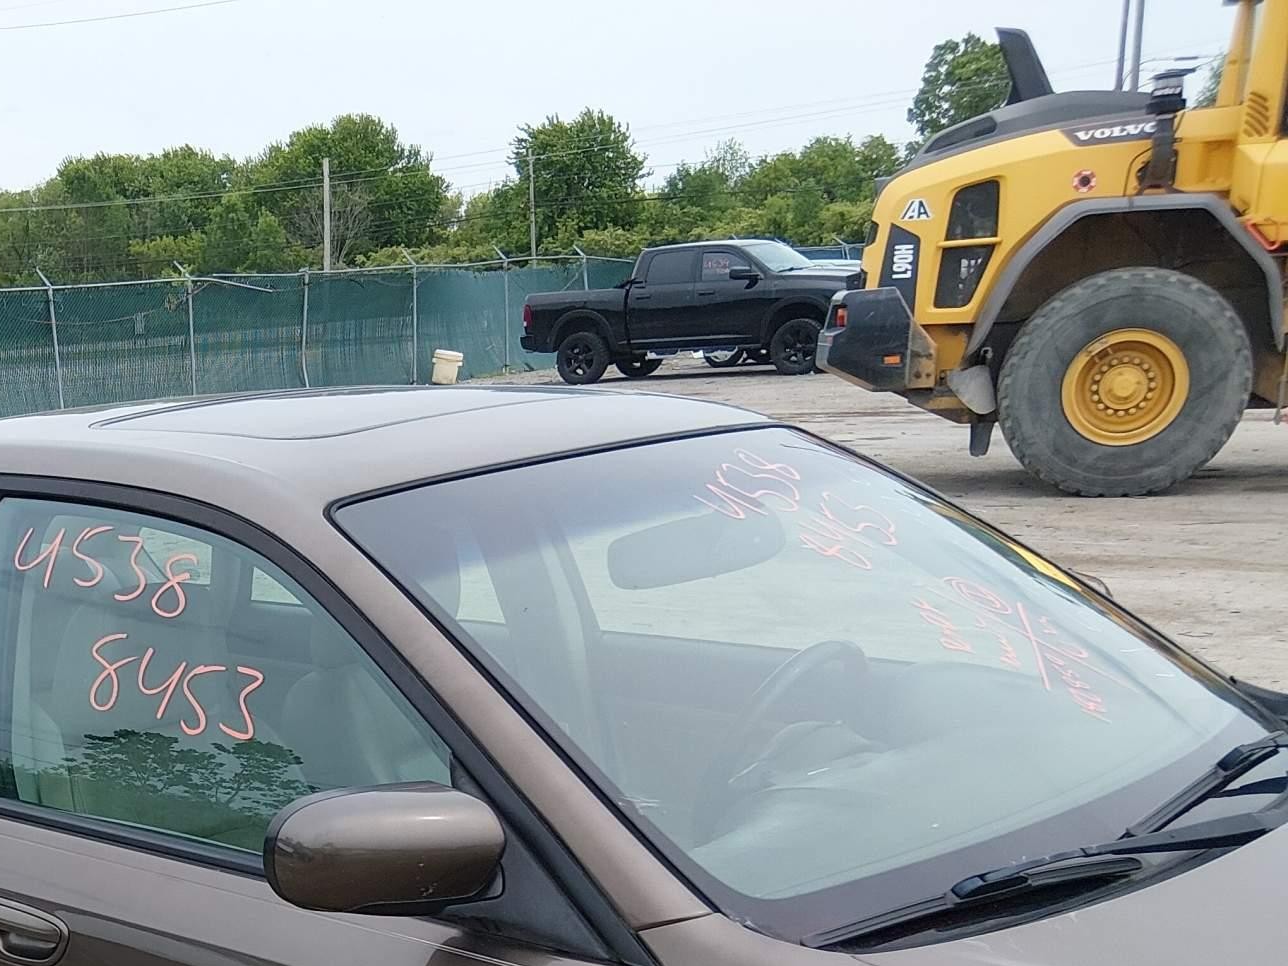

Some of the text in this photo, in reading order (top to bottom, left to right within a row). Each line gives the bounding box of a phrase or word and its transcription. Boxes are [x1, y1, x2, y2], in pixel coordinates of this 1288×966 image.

[891, 244, 915, 279] L90H
[692, 447, 801, 520] 4538
[799, 490, 898, 571] 8453
[14, 525, 199, 618] 4538
[89, 632, 264, 740] 8453
